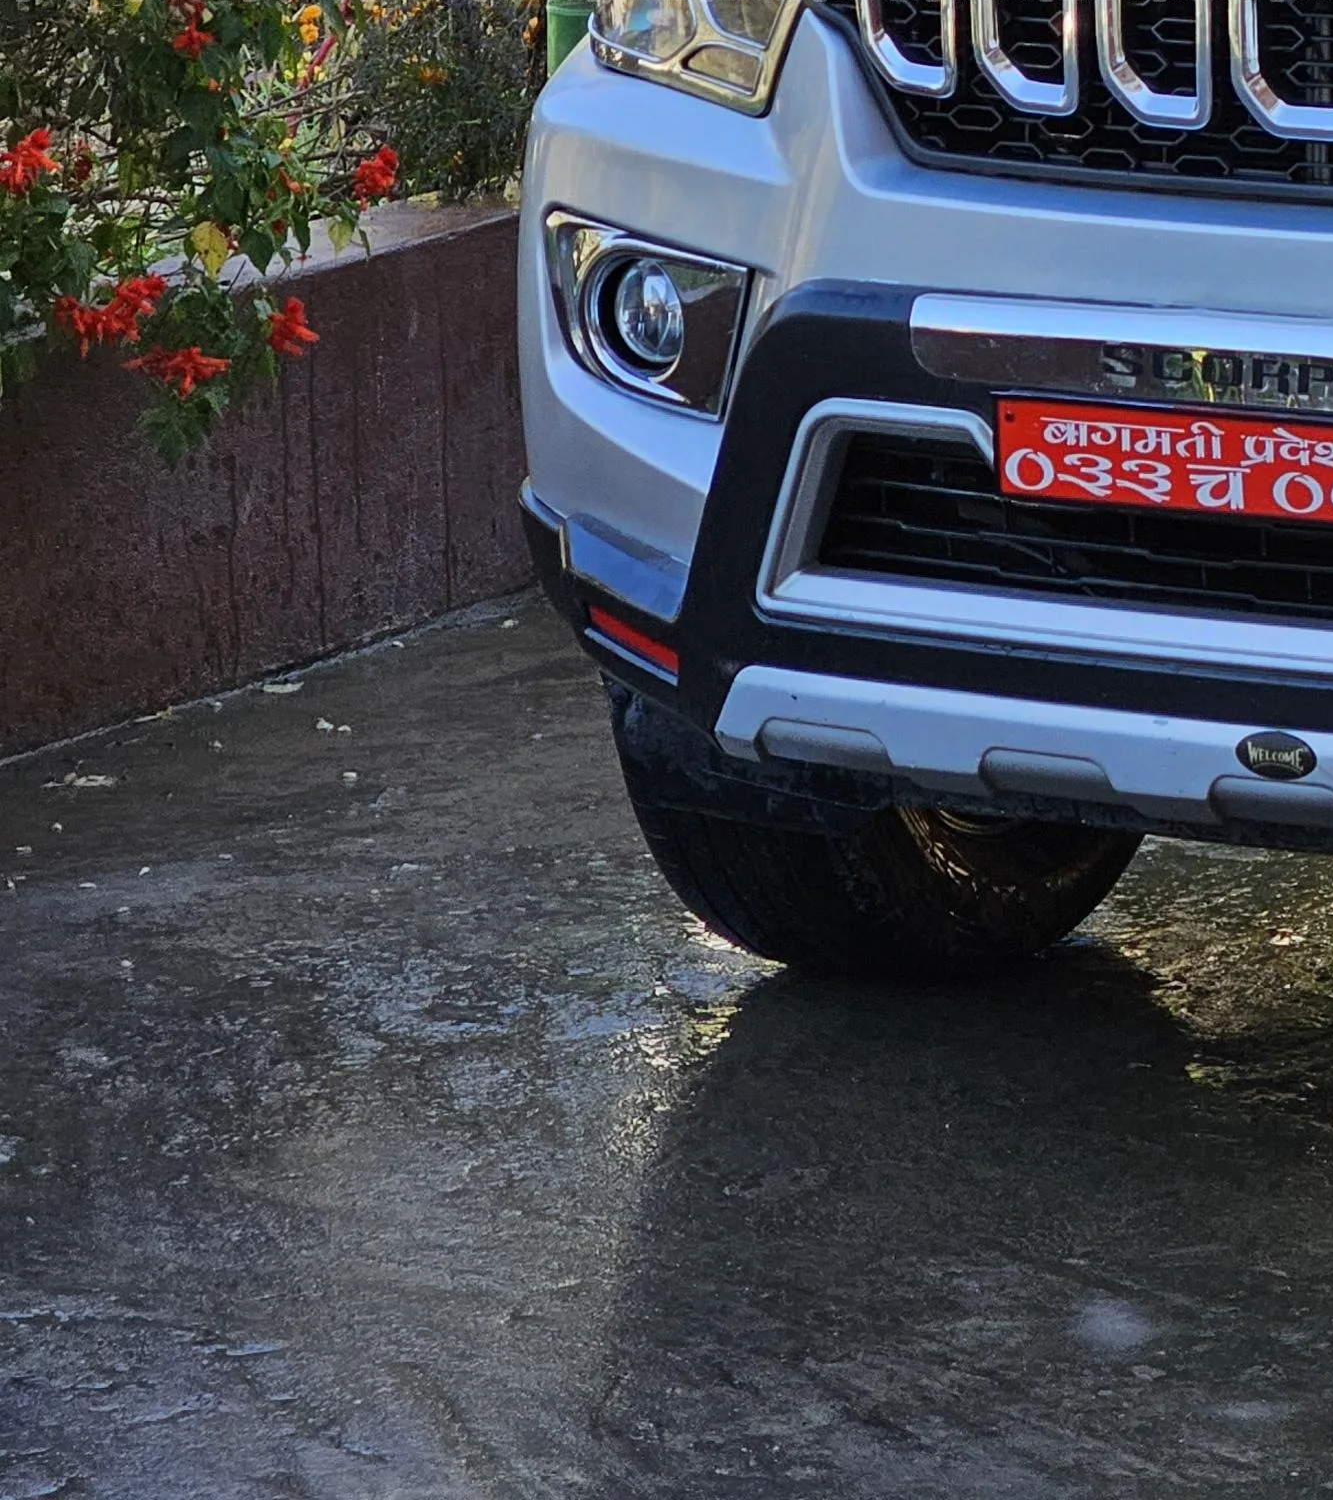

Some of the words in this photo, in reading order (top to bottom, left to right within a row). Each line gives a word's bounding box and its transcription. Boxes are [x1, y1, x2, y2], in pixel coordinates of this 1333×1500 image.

[1040, 416, 1224, 460] बागमती
[1005, 449, 1172, 503] ०३३
[1186, 464, 1251, 510] च
[1247, 741, 1304, 771] WELCOME
